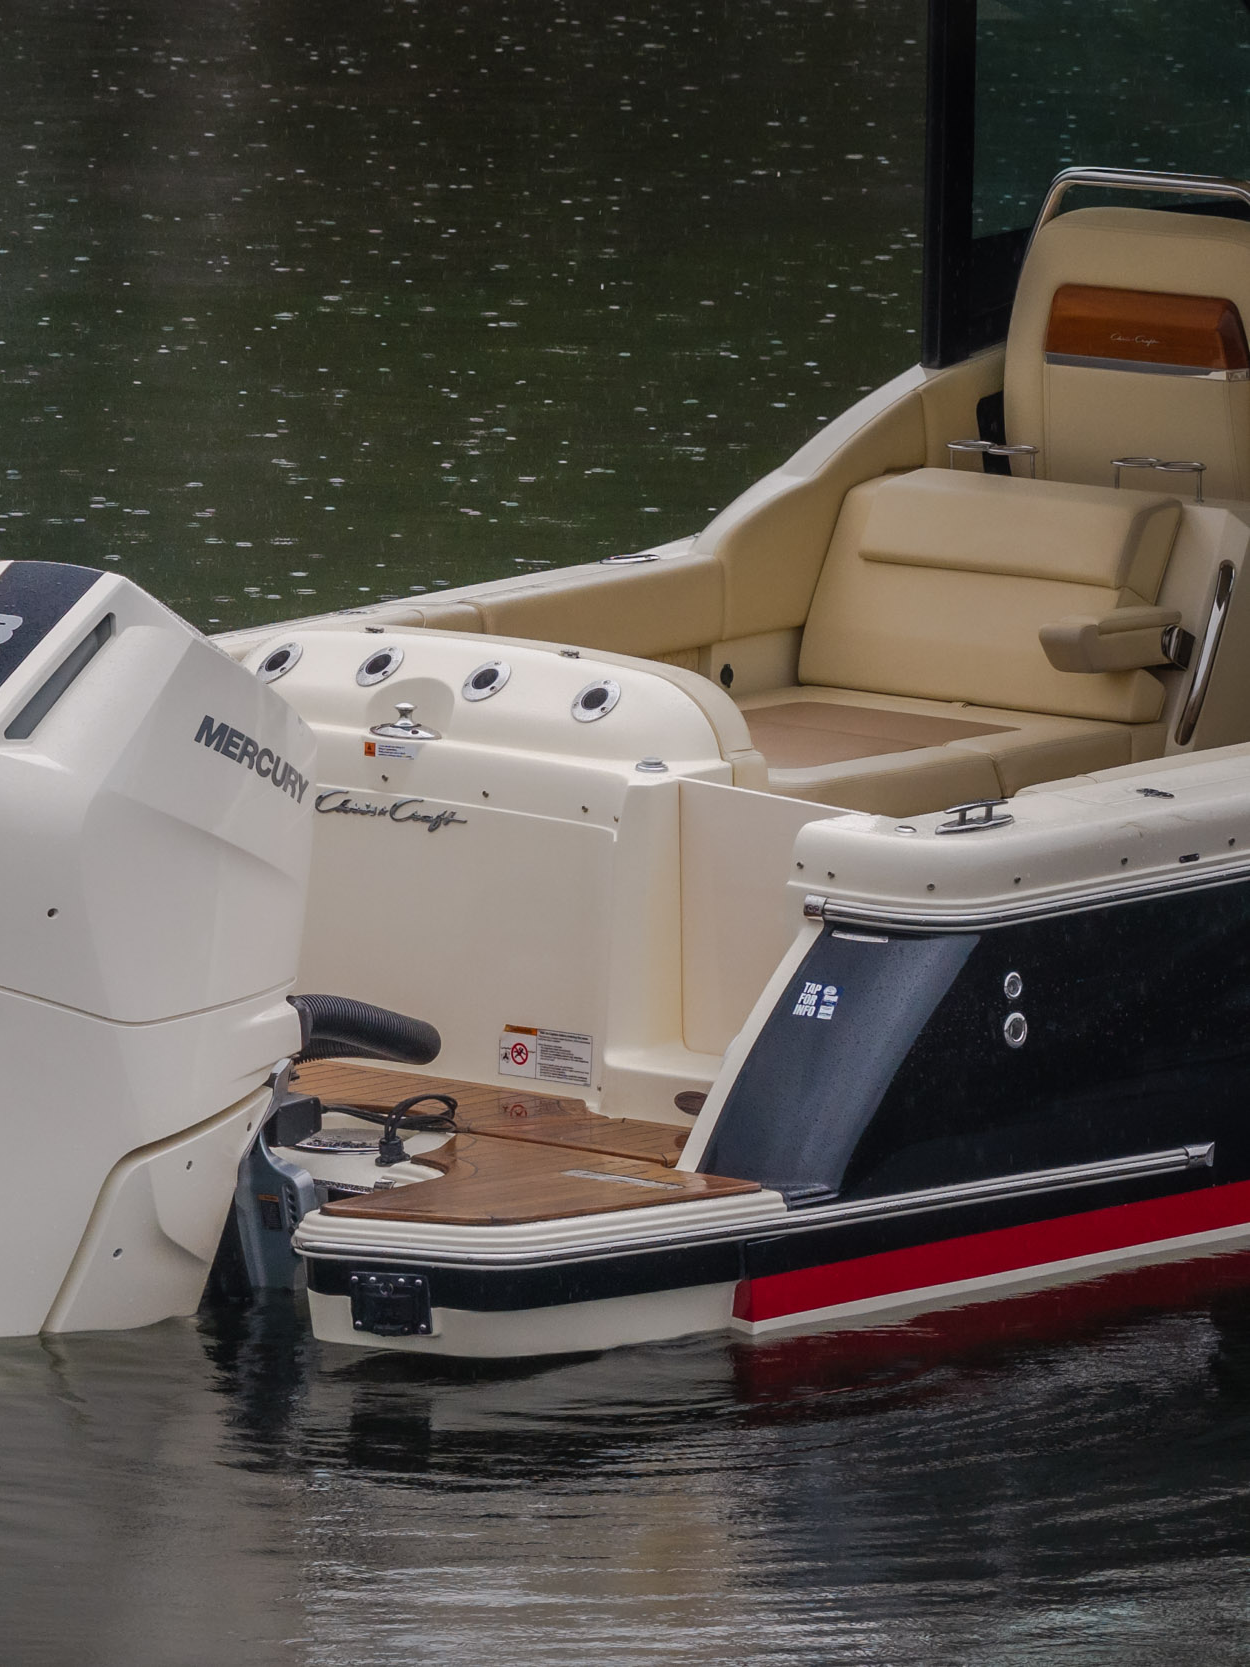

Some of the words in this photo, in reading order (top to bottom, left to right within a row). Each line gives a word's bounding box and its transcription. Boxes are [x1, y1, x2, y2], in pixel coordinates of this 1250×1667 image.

[194, 715, 310, 804] MERCURY
[803, 981, 823, 994] TAP
[797, 992, 818, 1006] FOR
[792, 1003, 816, 1017] INFO
